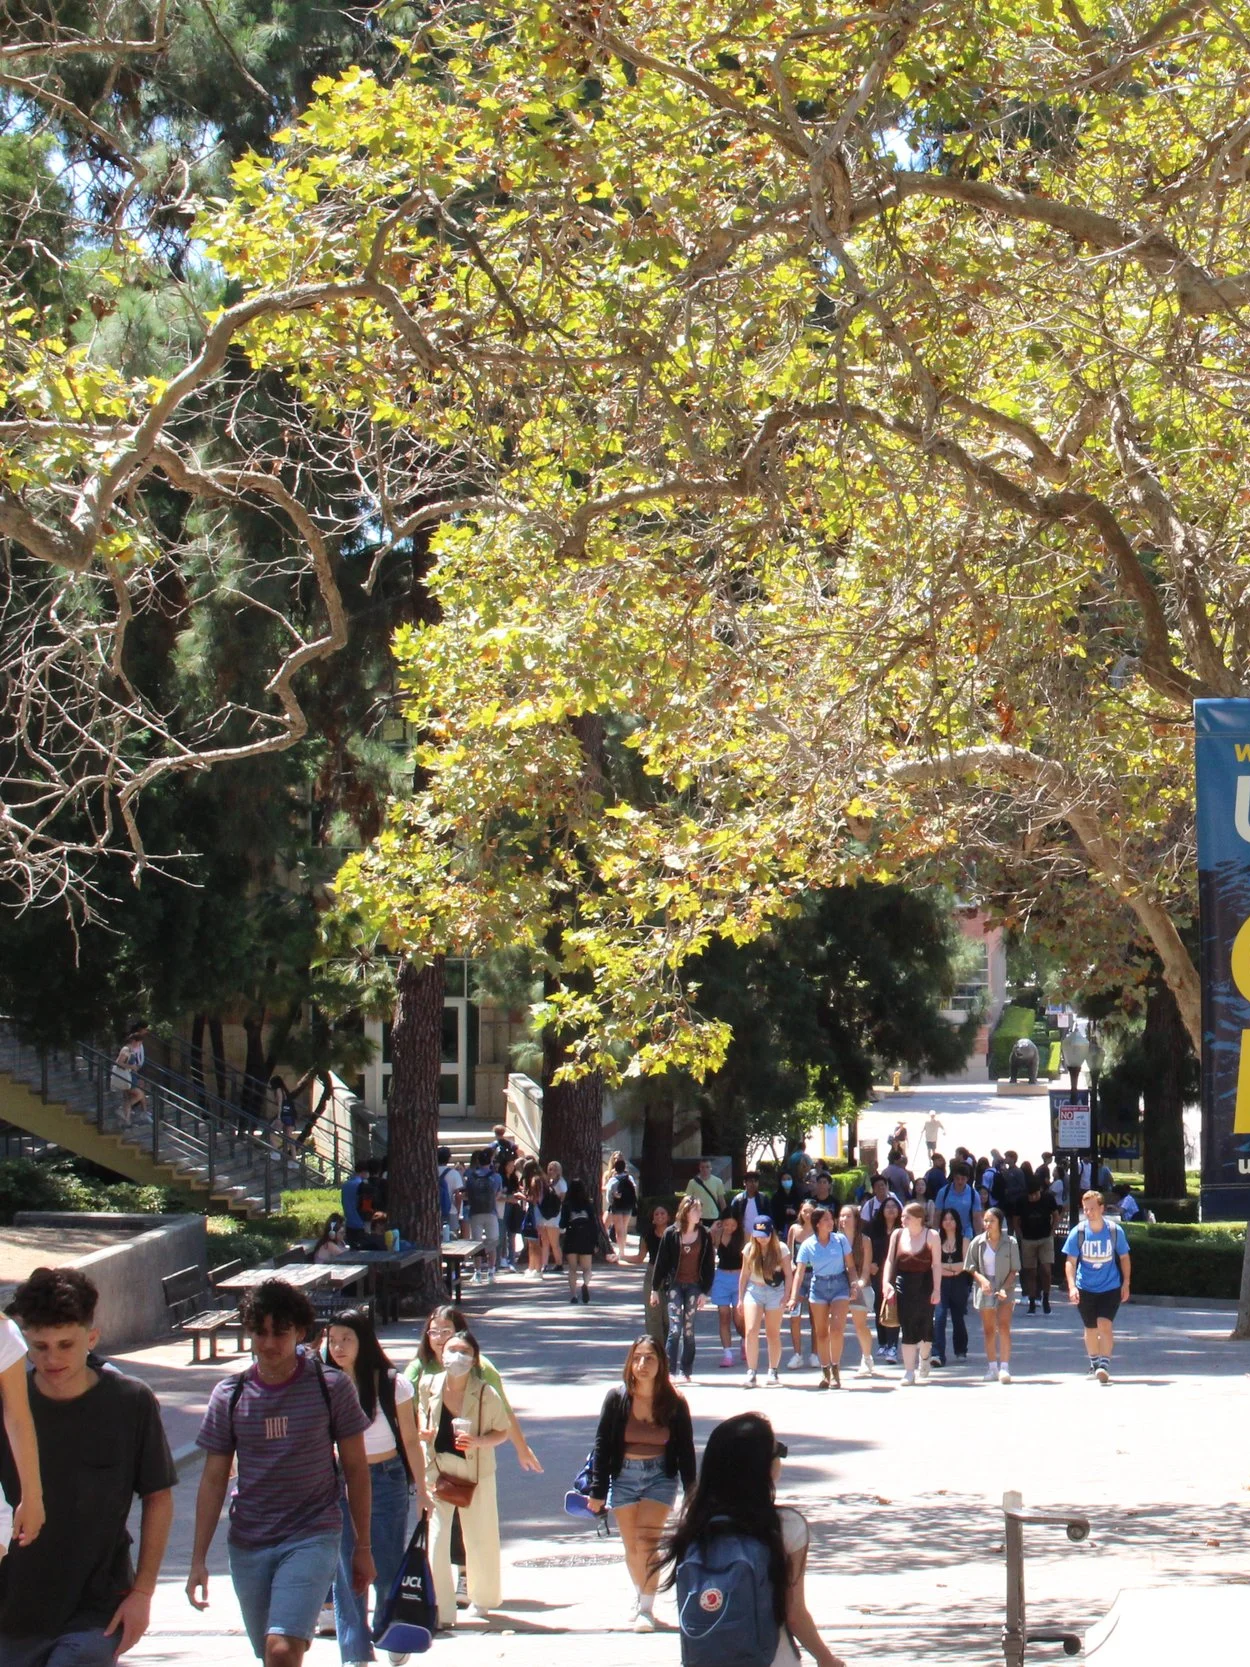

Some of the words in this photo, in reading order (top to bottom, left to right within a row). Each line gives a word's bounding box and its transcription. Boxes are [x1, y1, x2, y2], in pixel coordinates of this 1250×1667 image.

[1060, 1111, 1073, 1120] NO
[1081, 1240, 1113, 1259] UCLA
[401, 1575, 423, 1591] UCL
